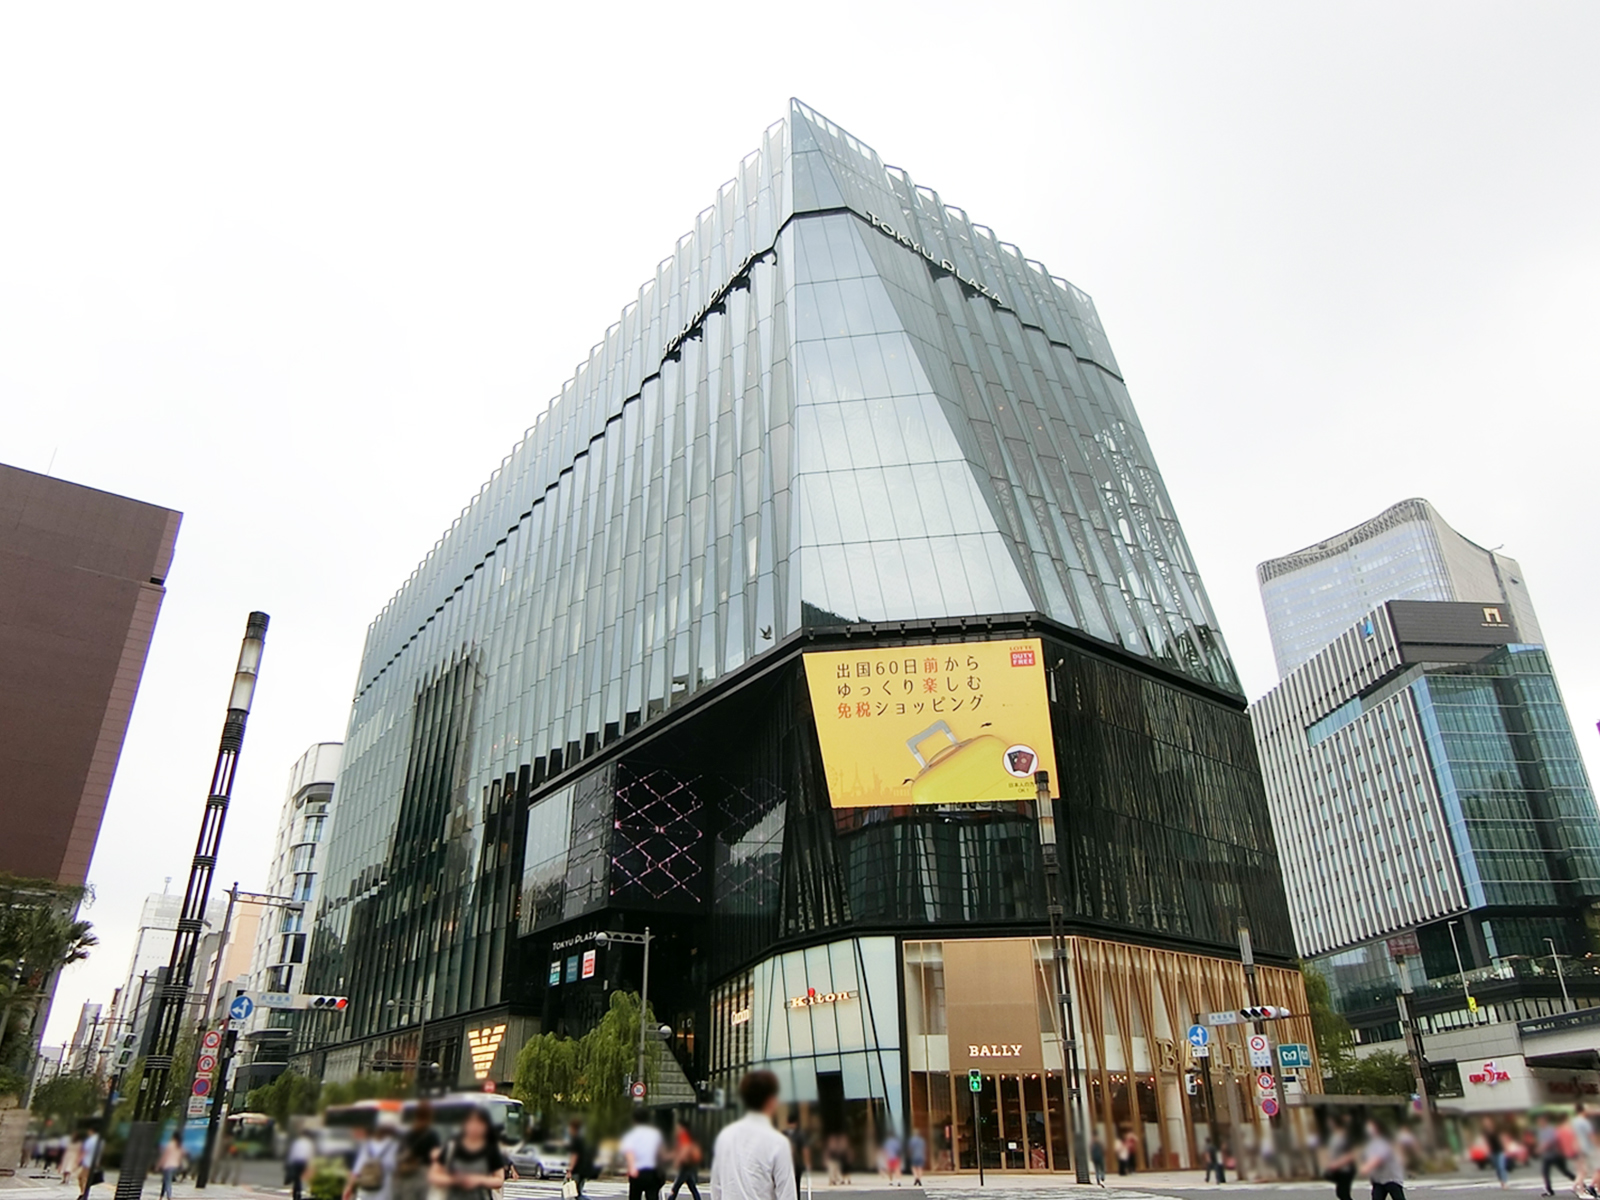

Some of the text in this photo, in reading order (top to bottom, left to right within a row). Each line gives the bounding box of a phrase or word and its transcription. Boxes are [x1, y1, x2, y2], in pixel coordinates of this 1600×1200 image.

[866, 210, 1004, 306] TOKYU PLAZA
[836, 655, 979, 679] 出国60日前から
[837, 675, 982, 697] ゆっくり楽しむ
[837, 694, 984, 719] 免税ショッピング
[552, 931, 598, 951] TOKYU PLAZA
[790, 987, 851, 1009] Kiton
[968, 1044, 1023, 1057] BALLY
